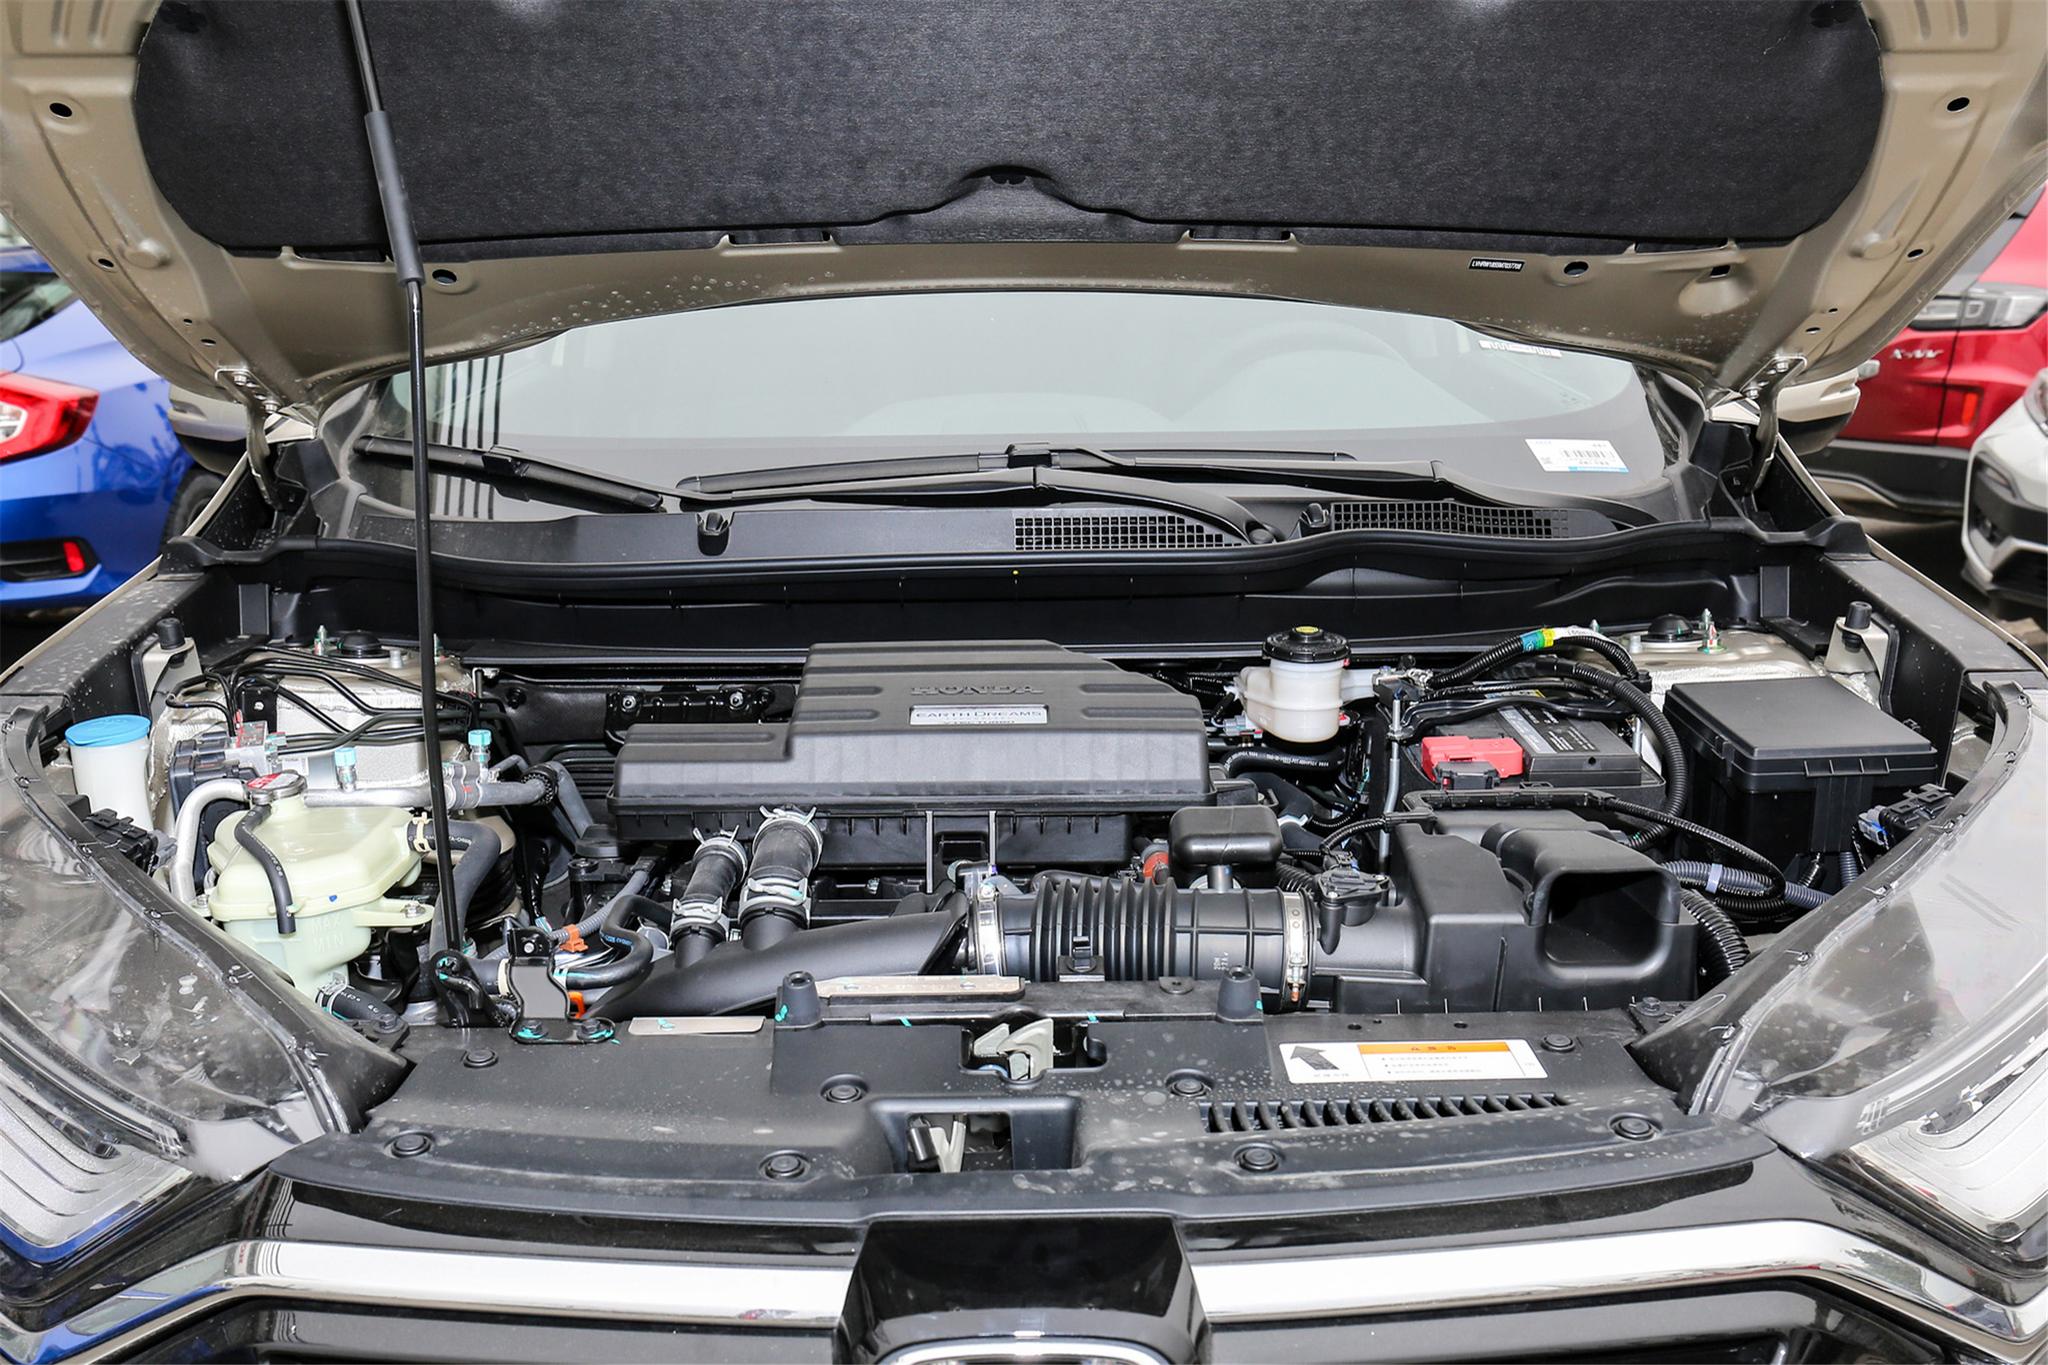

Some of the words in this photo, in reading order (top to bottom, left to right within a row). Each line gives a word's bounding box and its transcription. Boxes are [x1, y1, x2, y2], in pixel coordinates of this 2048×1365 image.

[911, 686, 1045, 696] HONDA
[311, 914, 345, 936] MAX
[312, 931, 345, 953] MIN
